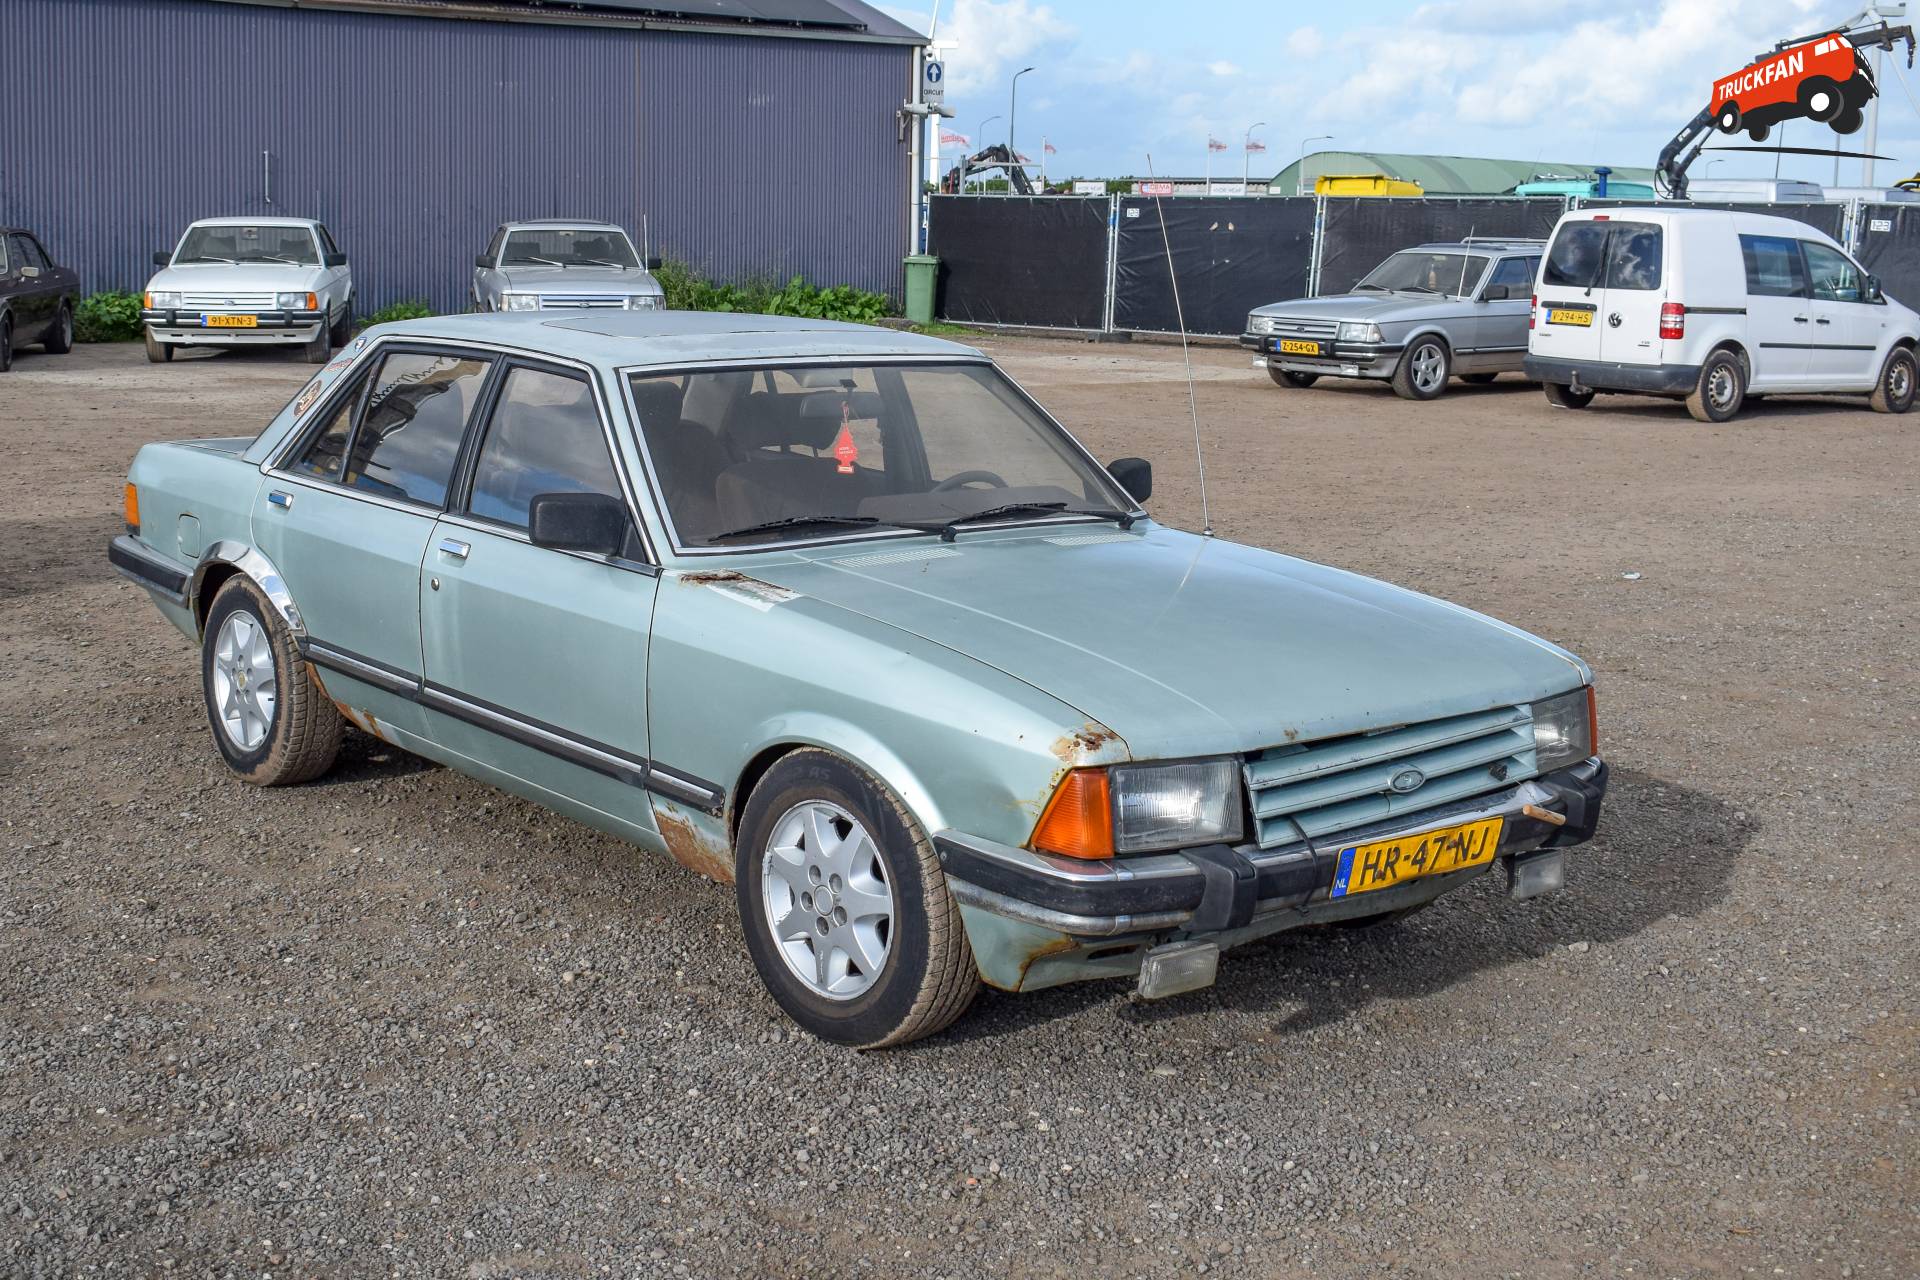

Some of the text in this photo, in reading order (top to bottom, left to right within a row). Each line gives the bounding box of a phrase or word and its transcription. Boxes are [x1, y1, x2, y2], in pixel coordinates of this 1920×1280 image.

[1872, 220, 1890, 231] 123
[211, 316, 252, 326] 91-XTN-3
[1552, 311, 1589, 323] V-294-HS
[1282, 341, 1315, 353] Z-254-GX
[1359, 827, 1490, 886] HR-47-NJ
[1335, 879, 1346, 889] NL
